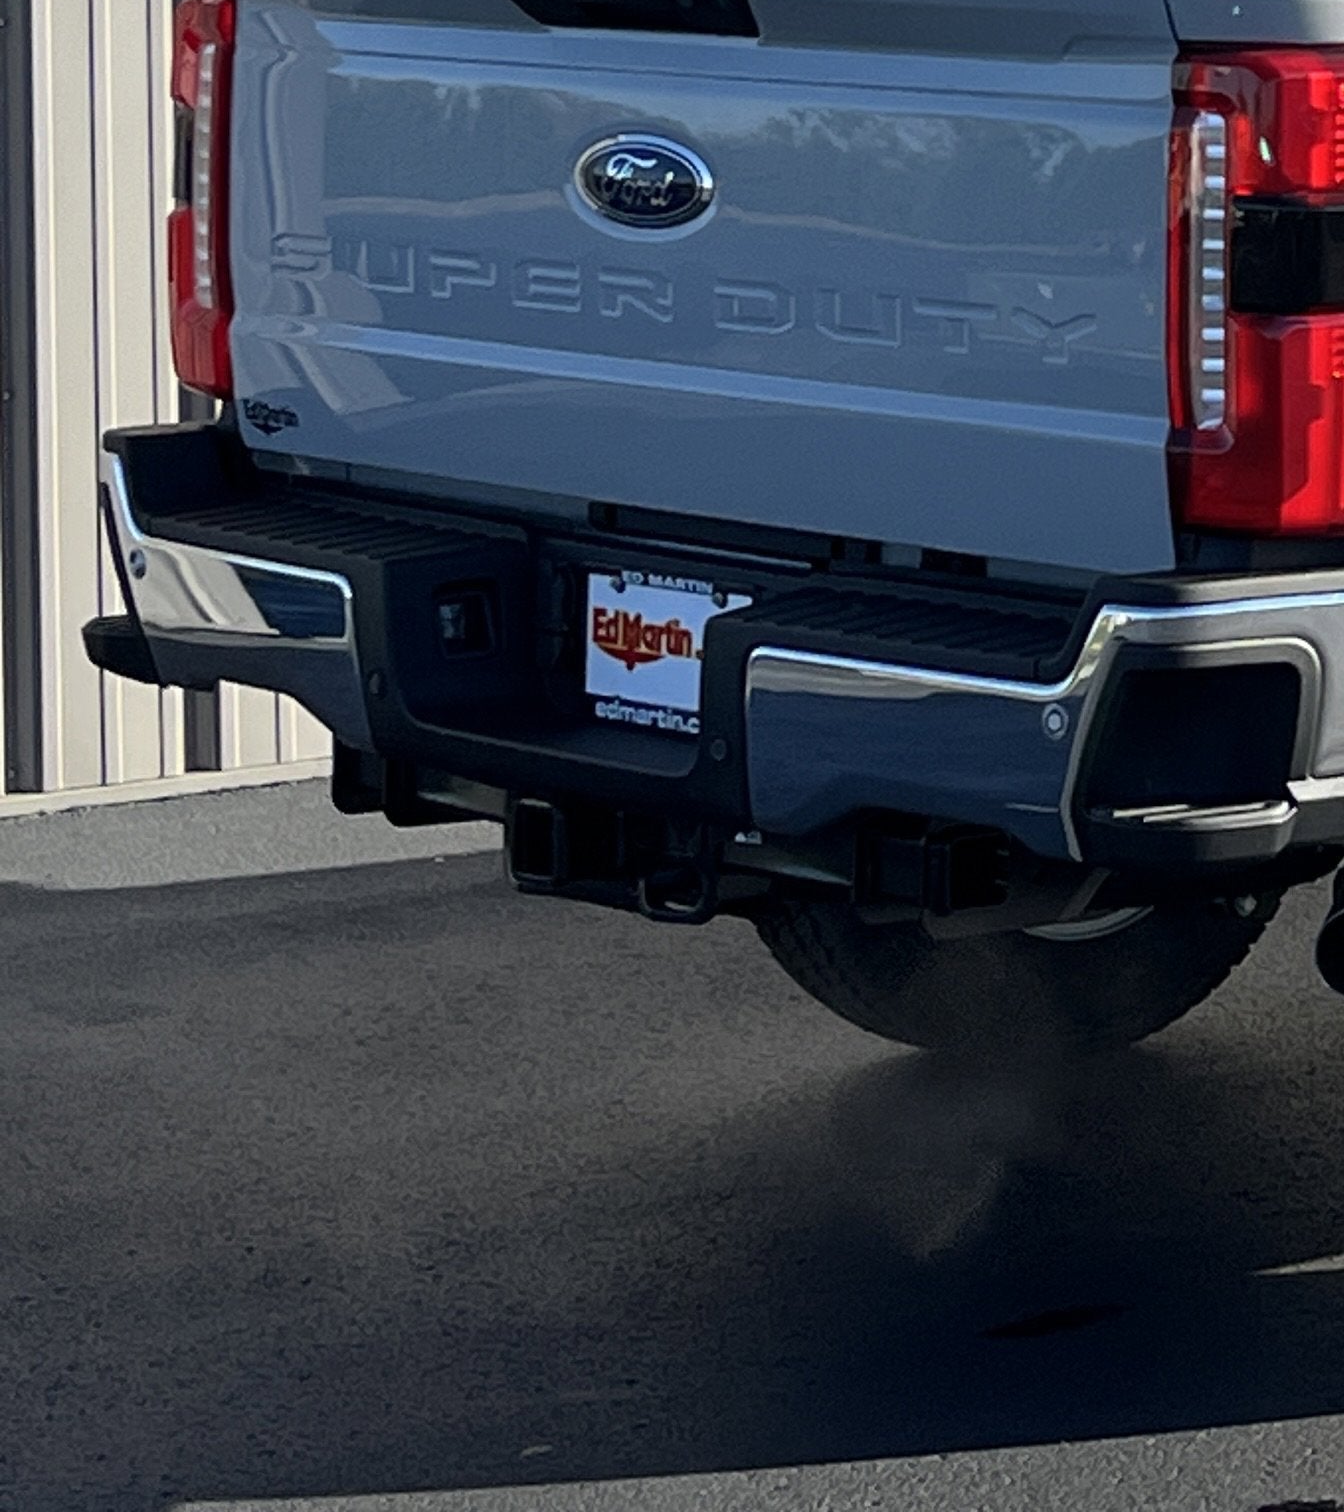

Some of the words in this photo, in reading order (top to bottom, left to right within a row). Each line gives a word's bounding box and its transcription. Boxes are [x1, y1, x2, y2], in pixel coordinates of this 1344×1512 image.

[596, 152, 676, 207] Ford
[271, 232, 674, 324] SUPER
[713, 277, 1098, 365] DUTY
[647, 573, 714, 593] MARTIN
